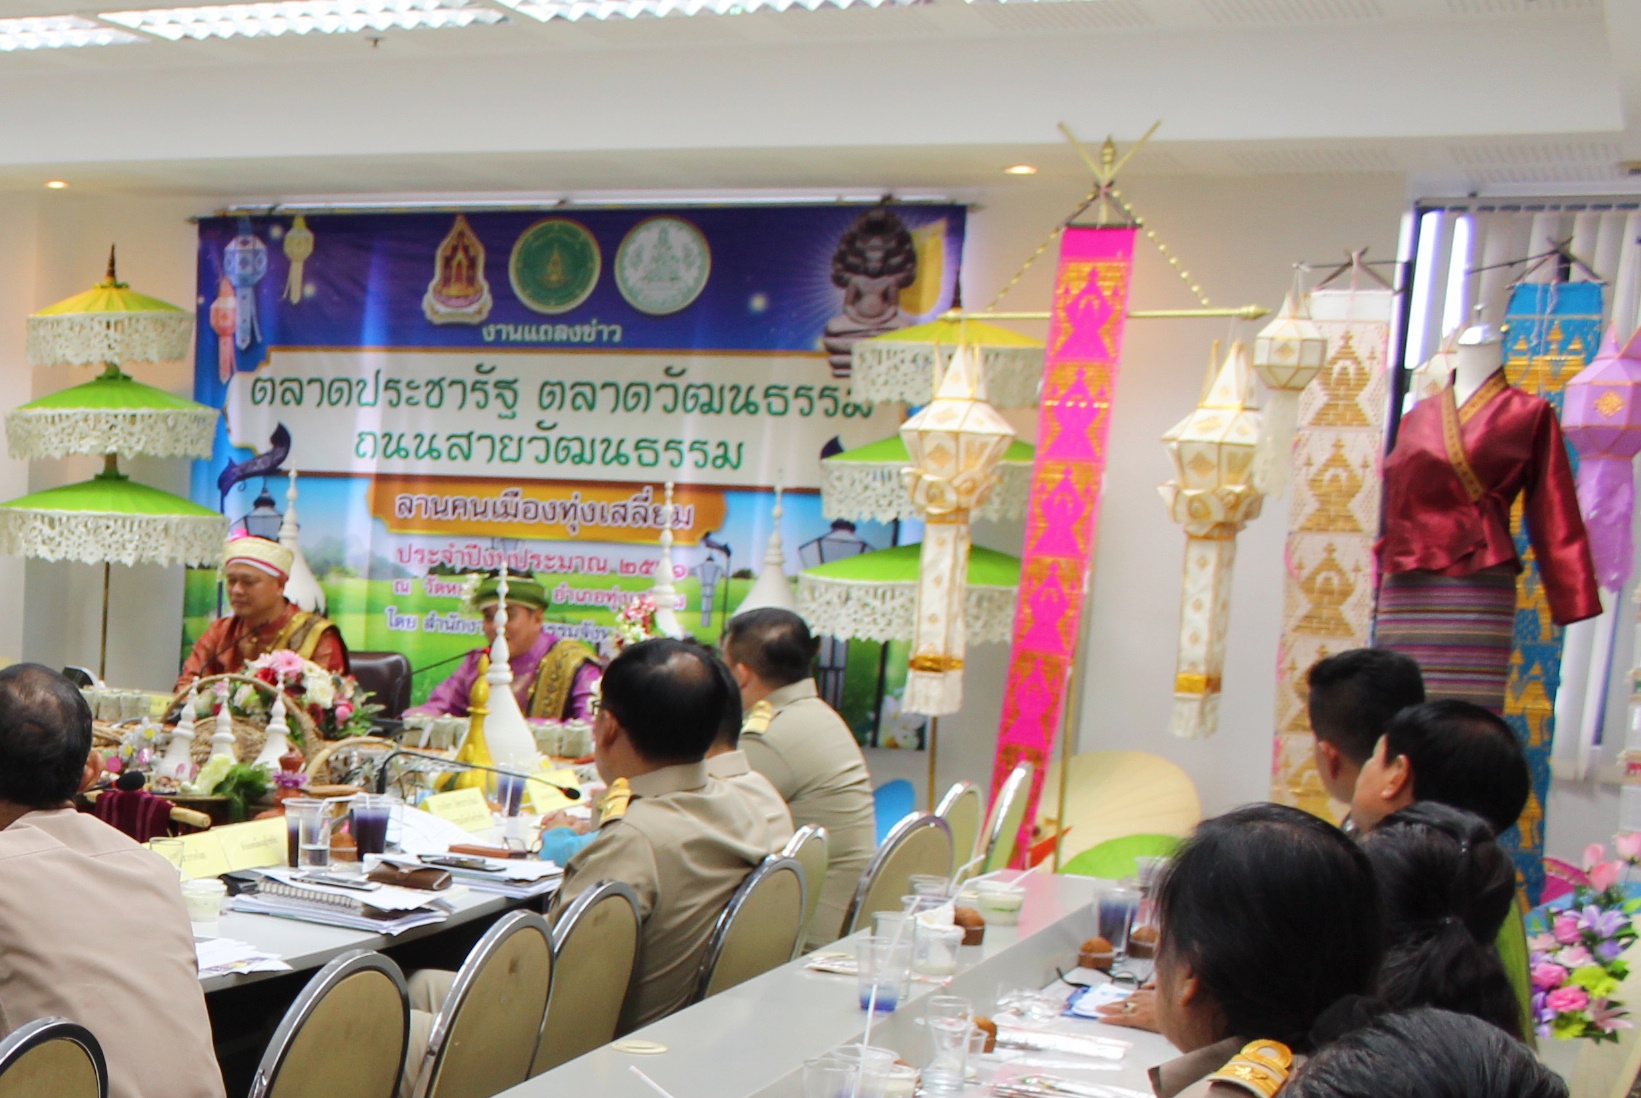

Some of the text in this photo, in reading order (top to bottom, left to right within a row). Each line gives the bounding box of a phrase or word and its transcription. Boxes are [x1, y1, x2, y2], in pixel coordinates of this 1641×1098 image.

[482, 318, 623, 343] งานแถลงข่าว
[250, 362, 520, 420] ตลาดประชารัฐ
[354, 419, 745, 470] ถนนสายวัฒนธรรม
[618, 558, 689, 578] ๒๕๑
[386, 607, 417, 630] โดย
